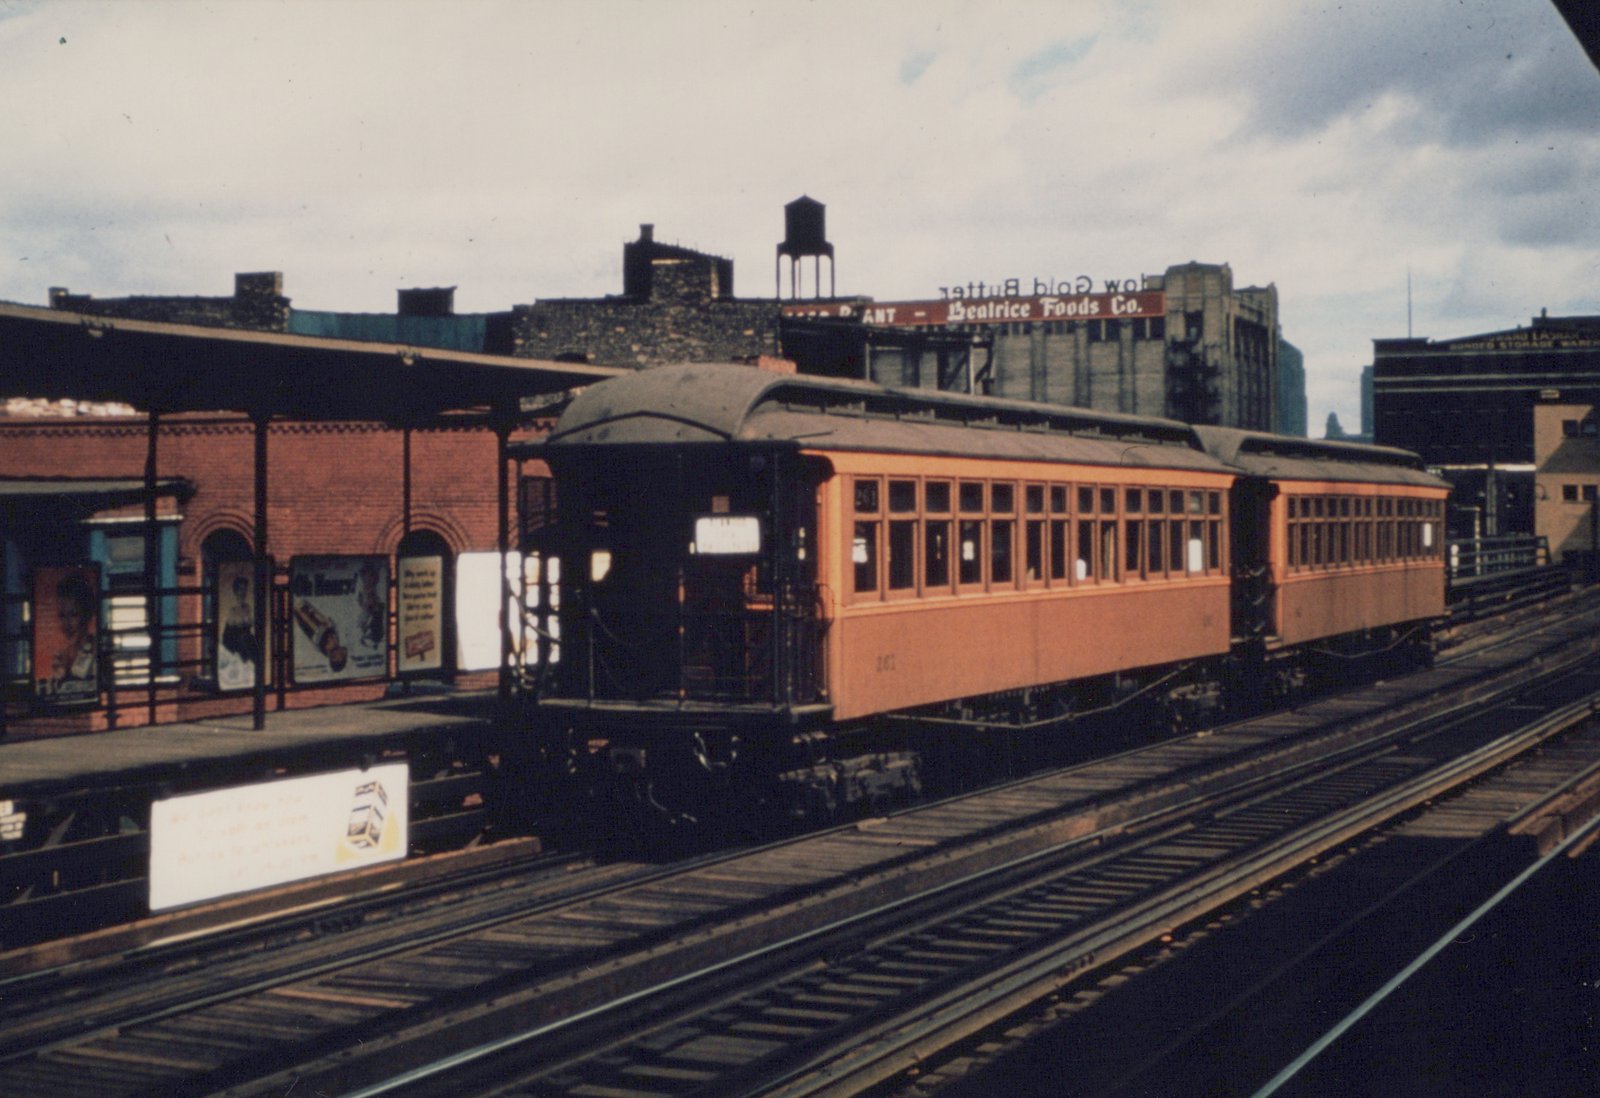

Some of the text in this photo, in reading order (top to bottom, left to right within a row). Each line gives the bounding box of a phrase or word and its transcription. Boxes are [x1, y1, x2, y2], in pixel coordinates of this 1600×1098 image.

[947, 299, 1031, 321] Beatrice
[1039, 297, 1100, 317] Foods
[1111, 294, 1143, 315] Co.
